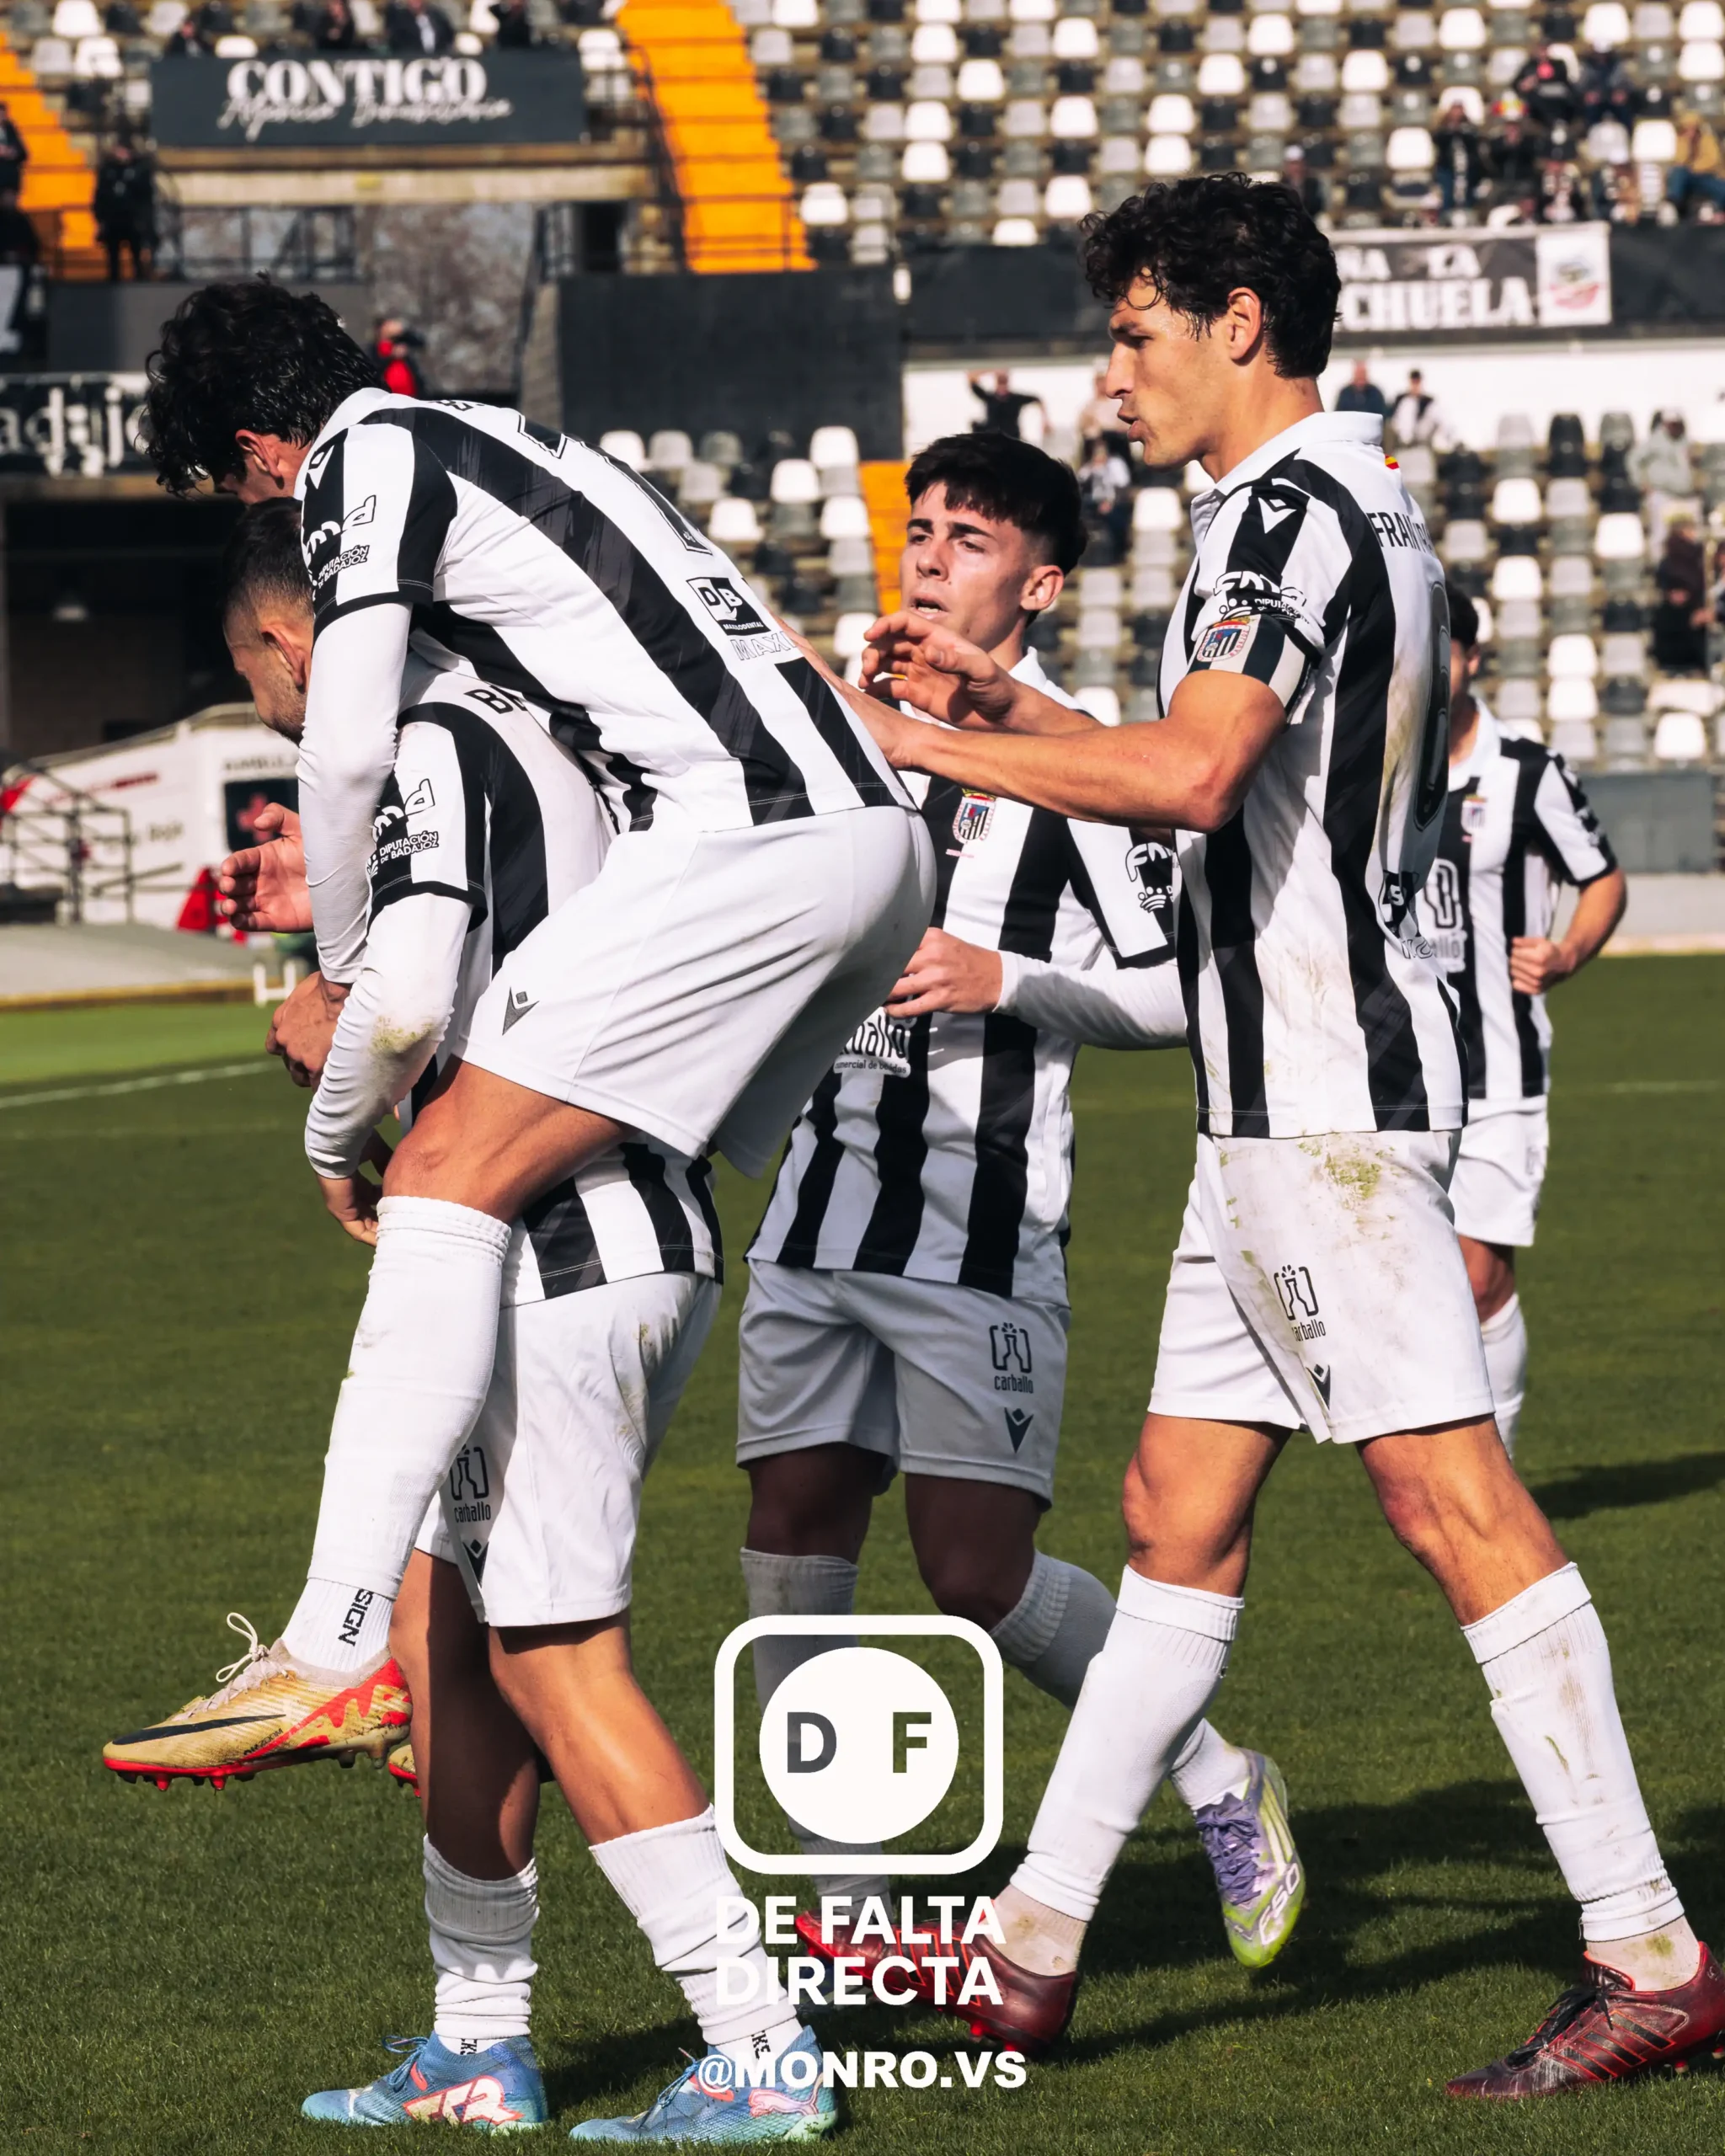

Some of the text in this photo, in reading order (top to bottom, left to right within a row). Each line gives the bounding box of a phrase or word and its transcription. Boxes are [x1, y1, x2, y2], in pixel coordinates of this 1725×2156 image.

[227, 58, 487, 107] CONTIGO
[379, 830, 439, 857] DIPUTACIÓN
[391, 840, 439, 860] BADAJOZ
[994, 1374, 1034, 1394] carballo
[454, 1502, 491, 1524] carballo
